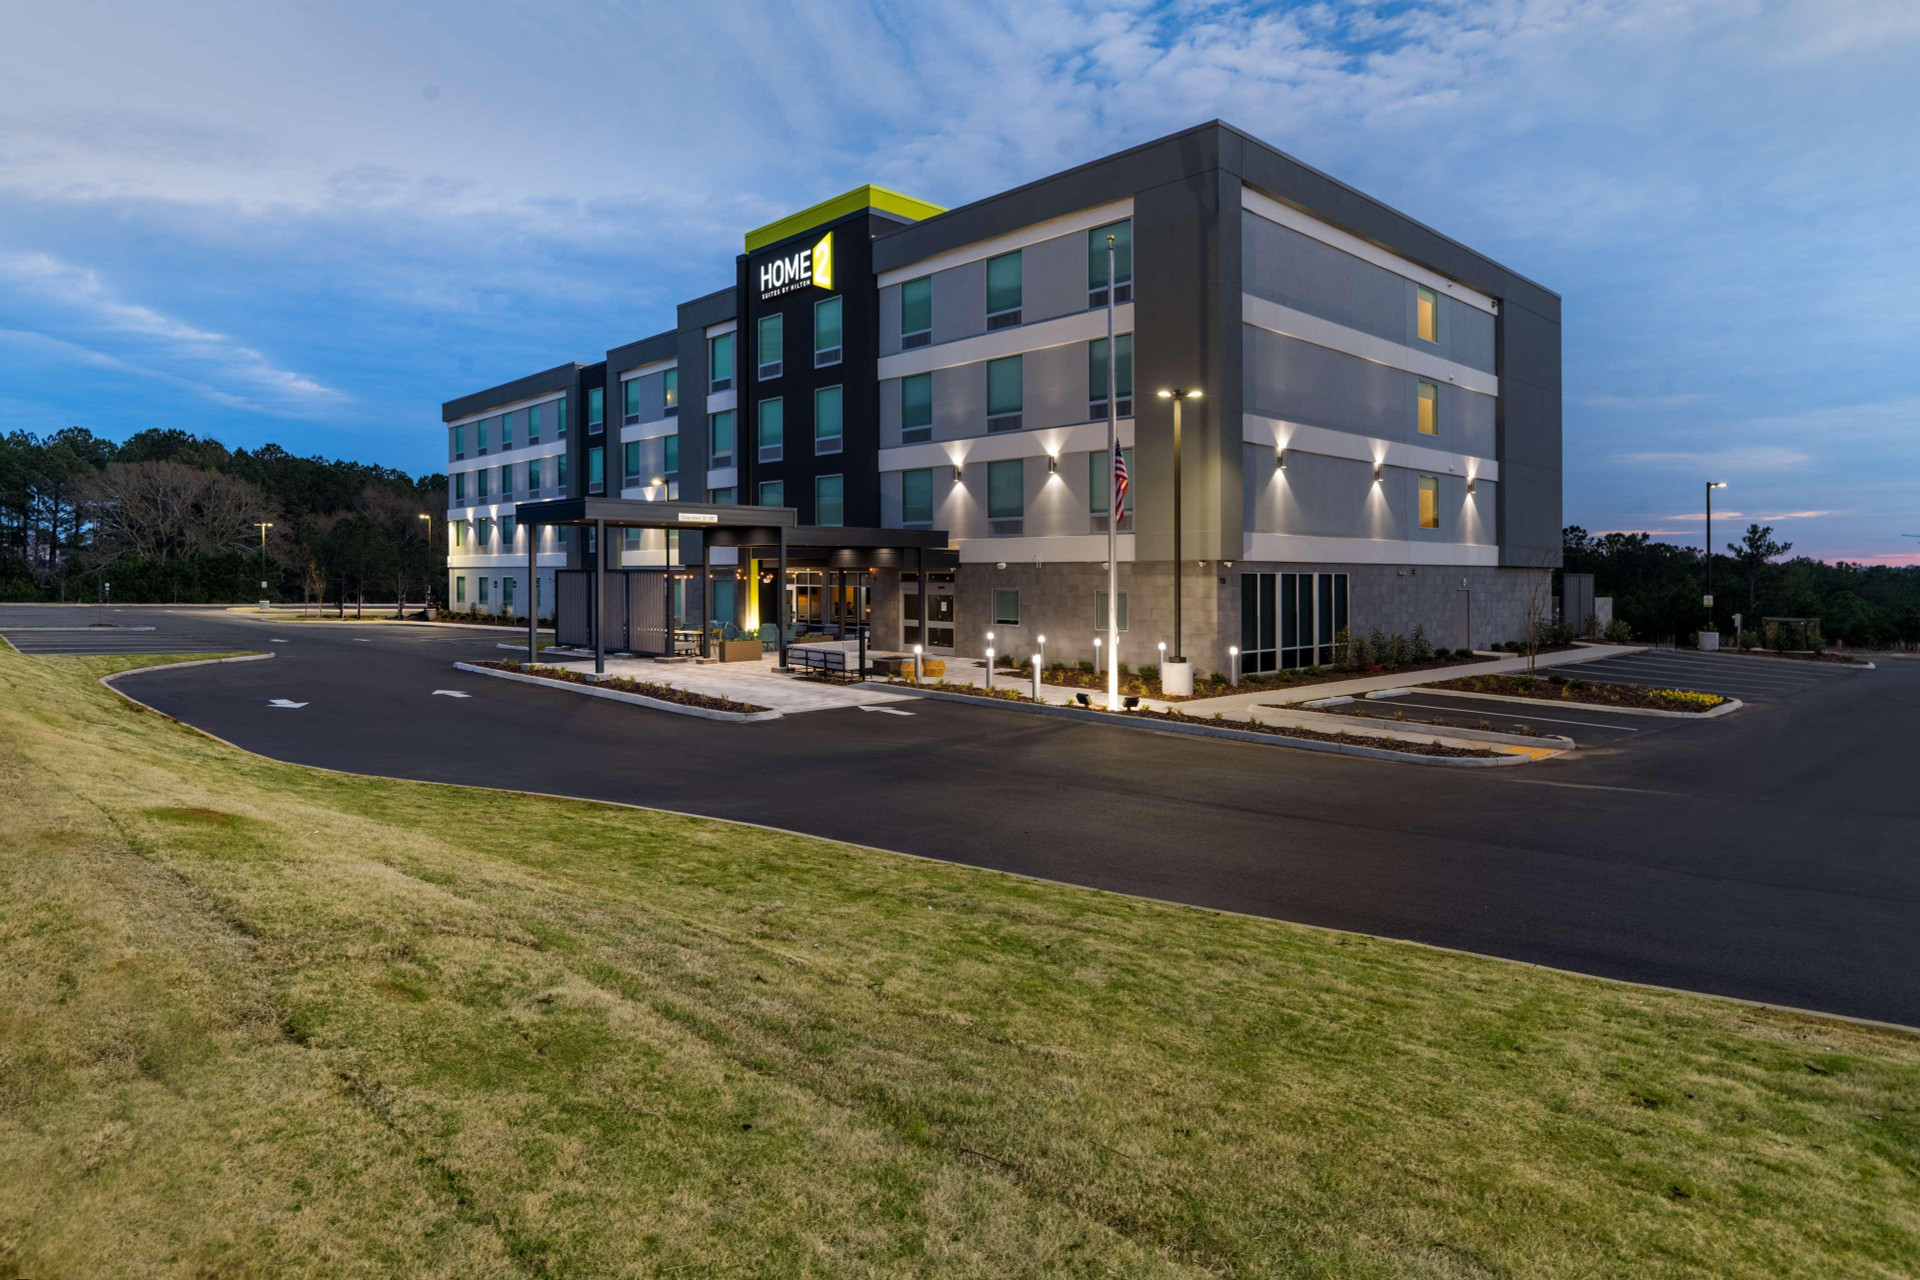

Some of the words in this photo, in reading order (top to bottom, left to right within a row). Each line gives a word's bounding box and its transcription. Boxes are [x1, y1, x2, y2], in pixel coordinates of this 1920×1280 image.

[762, 289, 781, 300] SUITES
[782, 286, 789, 294] BY
[790, 280, 810, 290] HILTON
